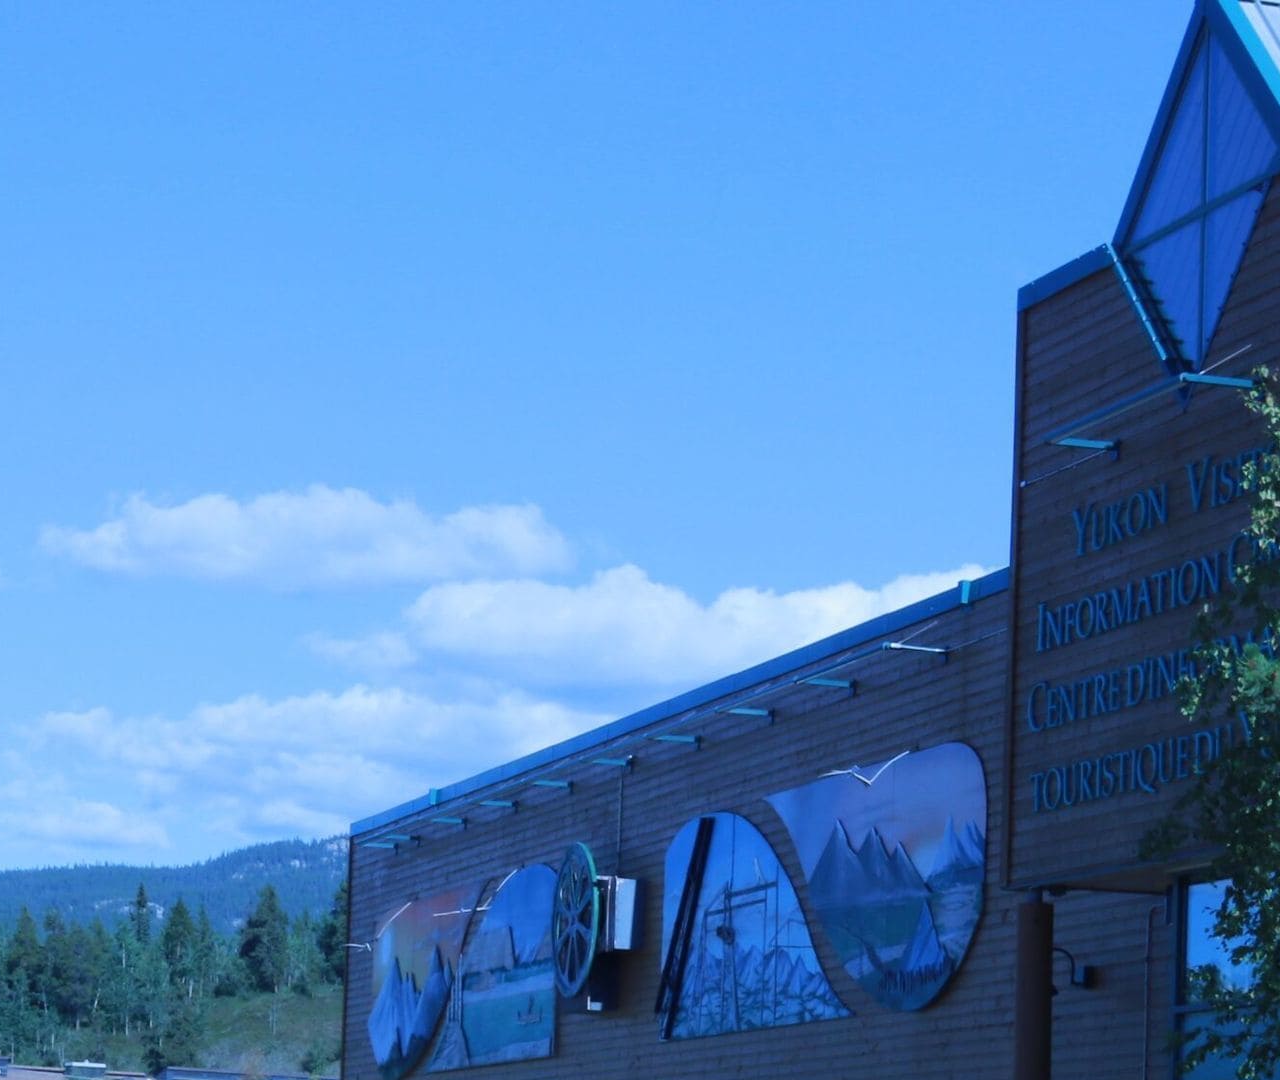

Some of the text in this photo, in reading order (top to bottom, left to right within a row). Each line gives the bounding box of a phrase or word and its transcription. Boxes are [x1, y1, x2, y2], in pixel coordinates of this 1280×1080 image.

[1071, 440, 1280, 557] YUKON VISIT
[1035, 553, 1222, 654] INFORMATION
[1026, 669, 1121, 733] CENTRE
[1030, 737, 1190, 813] TOURISTIQUE
